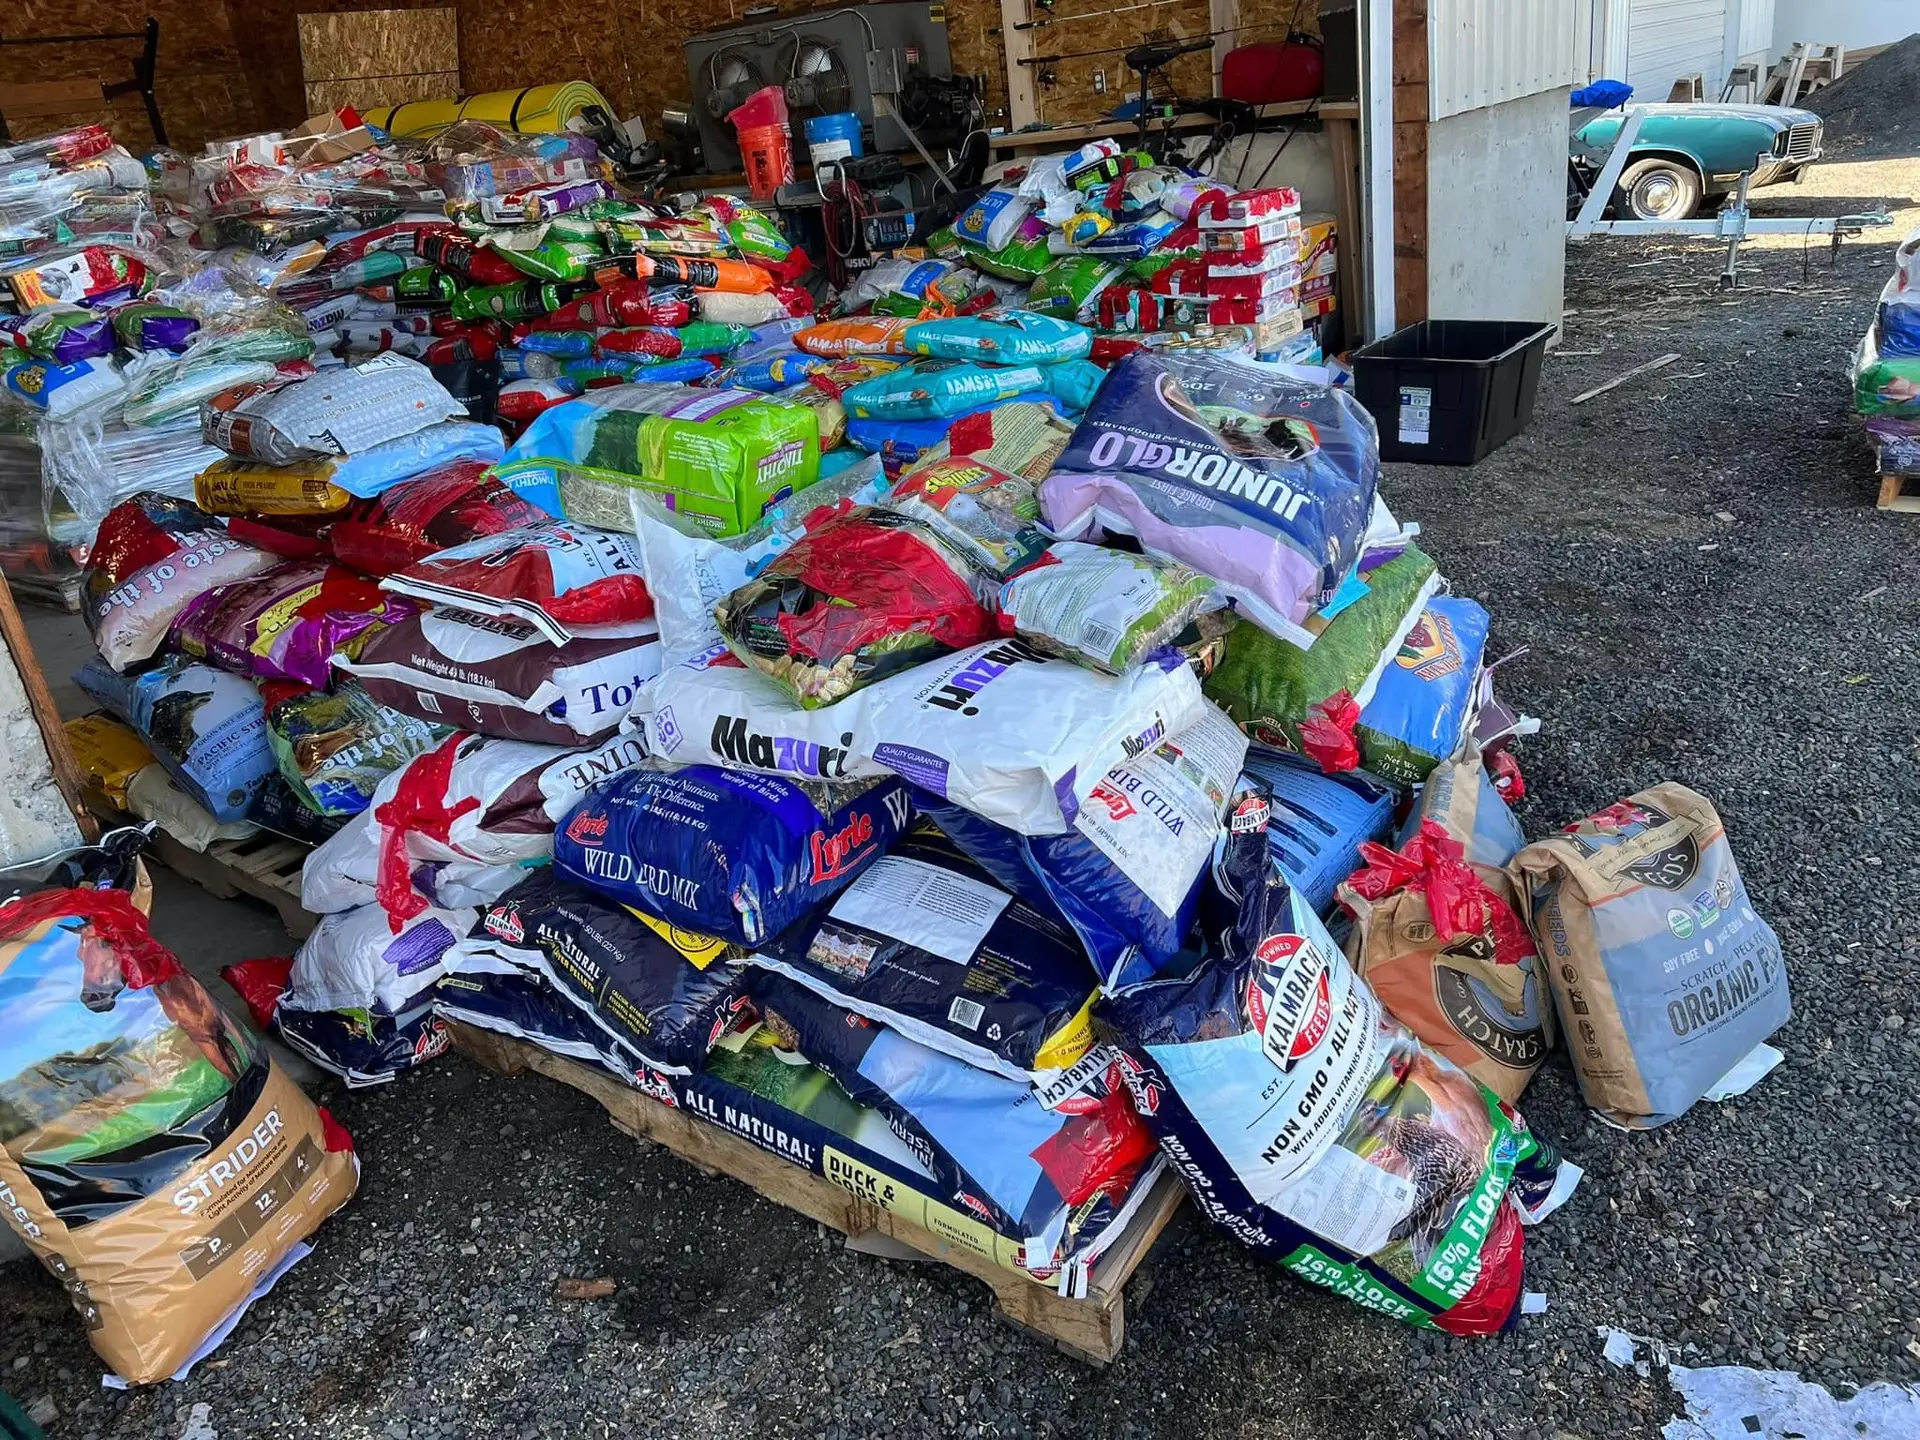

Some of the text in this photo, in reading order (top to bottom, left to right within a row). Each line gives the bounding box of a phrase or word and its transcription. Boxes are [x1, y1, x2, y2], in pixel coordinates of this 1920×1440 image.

[946, 374, 984, 396] IAMS
[514, 473, 554, 488] TIMOTHY
[1089, 432, 1311, 522] JUNIORGLO
[1150, 480, 1216, 512] FORAGE FIRST
[597, 535, 631, 571] ALL
[99, 538, 250, 618] aste of the
[927, 638, 1058, 716] Mazuri
[198, 731, 241, 766] PACIFIC
[321, 732, 397, 772] of the
[563, 737, 651, 791] UINE
[710, 714, 854, 780] Mazuri
[882, 745, 945, 768] QUALITY GUARANTEE
[1383, 752, 1399, 765] Net
[721, 771, 749, 789] Variety
[758, 786, 782, 804] Birds
[767, 779, 790, 798] Wide
[1396, 765, 1421, 780] LBS
[678, 779, 720, 802] Nutrients.
[1089, 778, 1138, 823] Lyri
[565, 808, 610, 846] Lyric
[1141, 790, 1185, 838] WILD
[810, 810, 878, 886] Lyric
[584, 846, 701, 912] WILD MIX
[1634, 851, 1689, 886] FEEDS
[537, 923, 560, 941] ALL
[1263, 941, 1291, 960] OWNED
[1663, 947, 1700, 974] SOY FREE
[1680, 959, 1728, 992] SCRATCH
[1255, 986, 1265, 1021] FAMILY
[1267, 947, 1322, 1059] KALMBACH
[1667, 959, 1759, 1037] ORGANIC
[1305, 998, 1330, 1046] FEEDS
[1013, 1091, 1031, 1108] 1963
[1067, 1099, 1093, 1110] OWNED
[1261, 1079, 1283, 1101] EST.
[1261, 1017, 1351, 1164] NON GMO ALL
[1291, 1032, 1367, 1155] WITH ADDED VITAMINS AND
[685, 1088, 814, 1164] ALL NATURAL
[172, 1110, 285, 1217] STRIDER
[246, 1146, 278, 1179] Maintenance
[1162, 1135, 1192, 1161] NON
[208, 1202, 226, 1220] Light
[226, 1186, 249, 1208] Activity
[255, 1159, 273, 1181] Mature
[829, 1154, 896, 1203] DUCK &
[0, 1180, 43, 1239] IDER
[1459, 1174, 1505, 1240] FLOCK
[208, 1237, 222, 1253] P
[932, 1217, 980, 1246] FORMULATED
[944, 1231, 988, 1257] WATERFOWL
[1425, 1241, 1471, 1292] 16%
